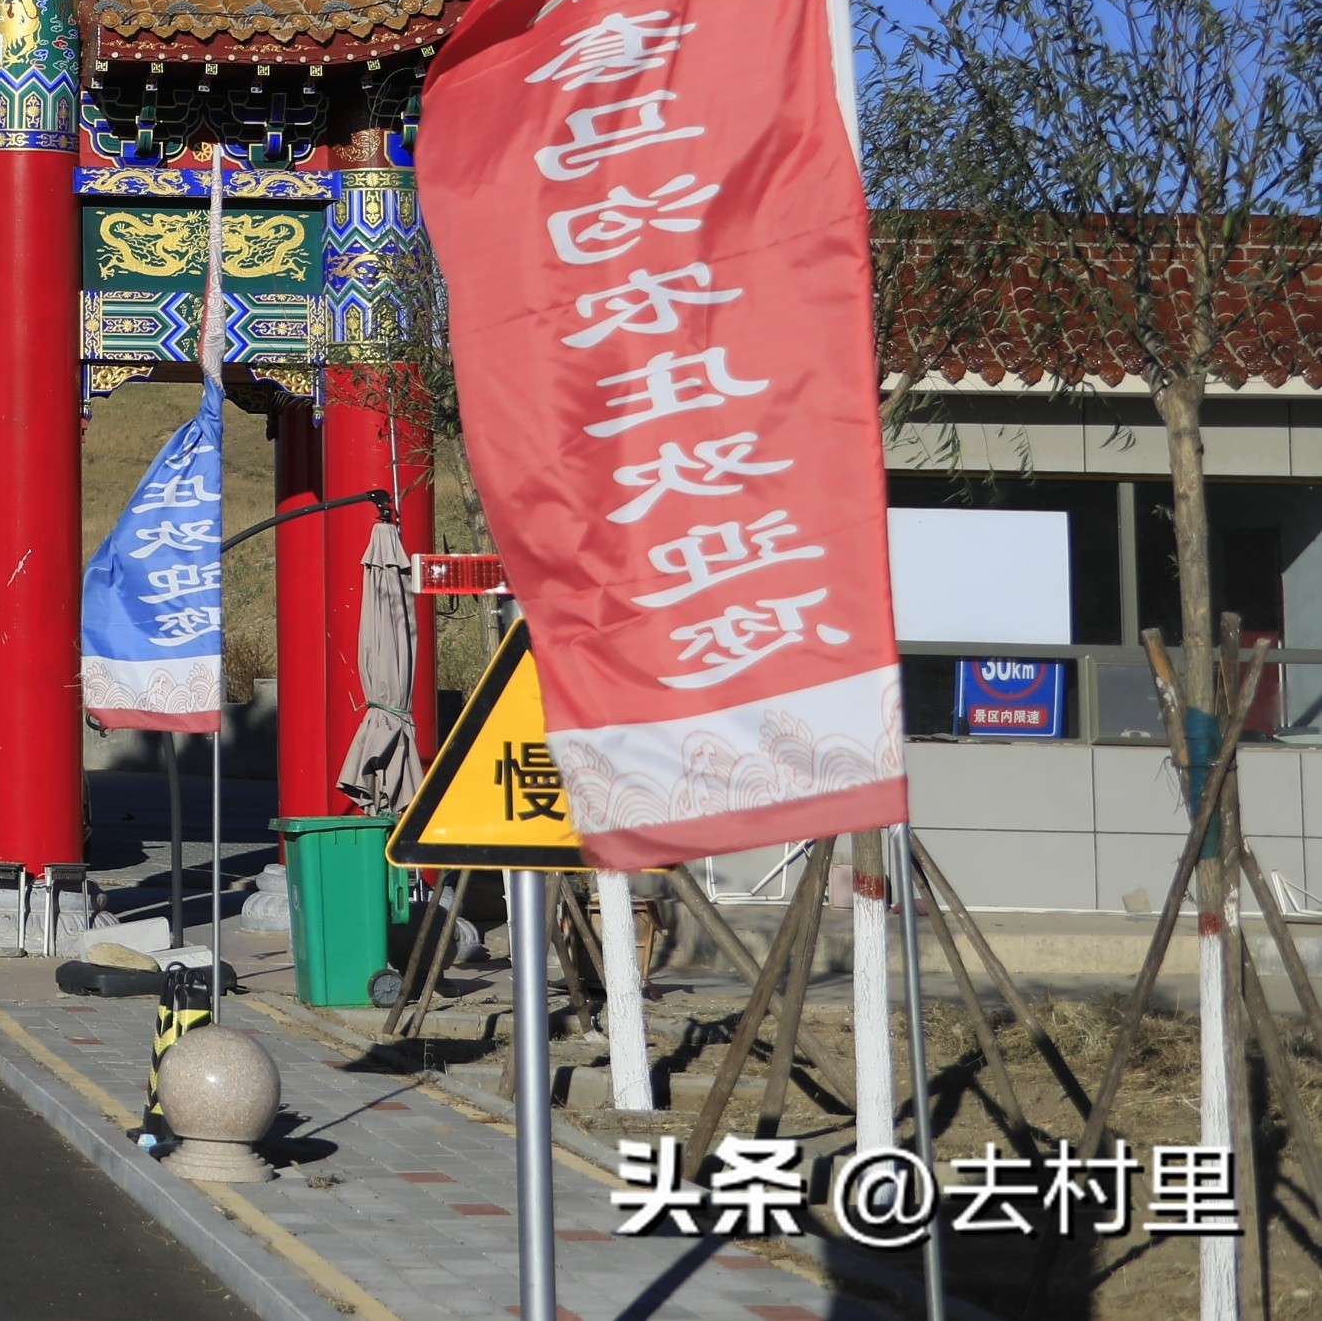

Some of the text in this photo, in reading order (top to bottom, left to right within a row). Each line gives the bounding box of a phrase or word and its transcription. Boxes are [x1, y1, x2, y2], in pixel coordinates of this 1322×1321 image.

[973, 709, 1040, 724] 景区内限速
[494, 740, 566, 821] 慢
